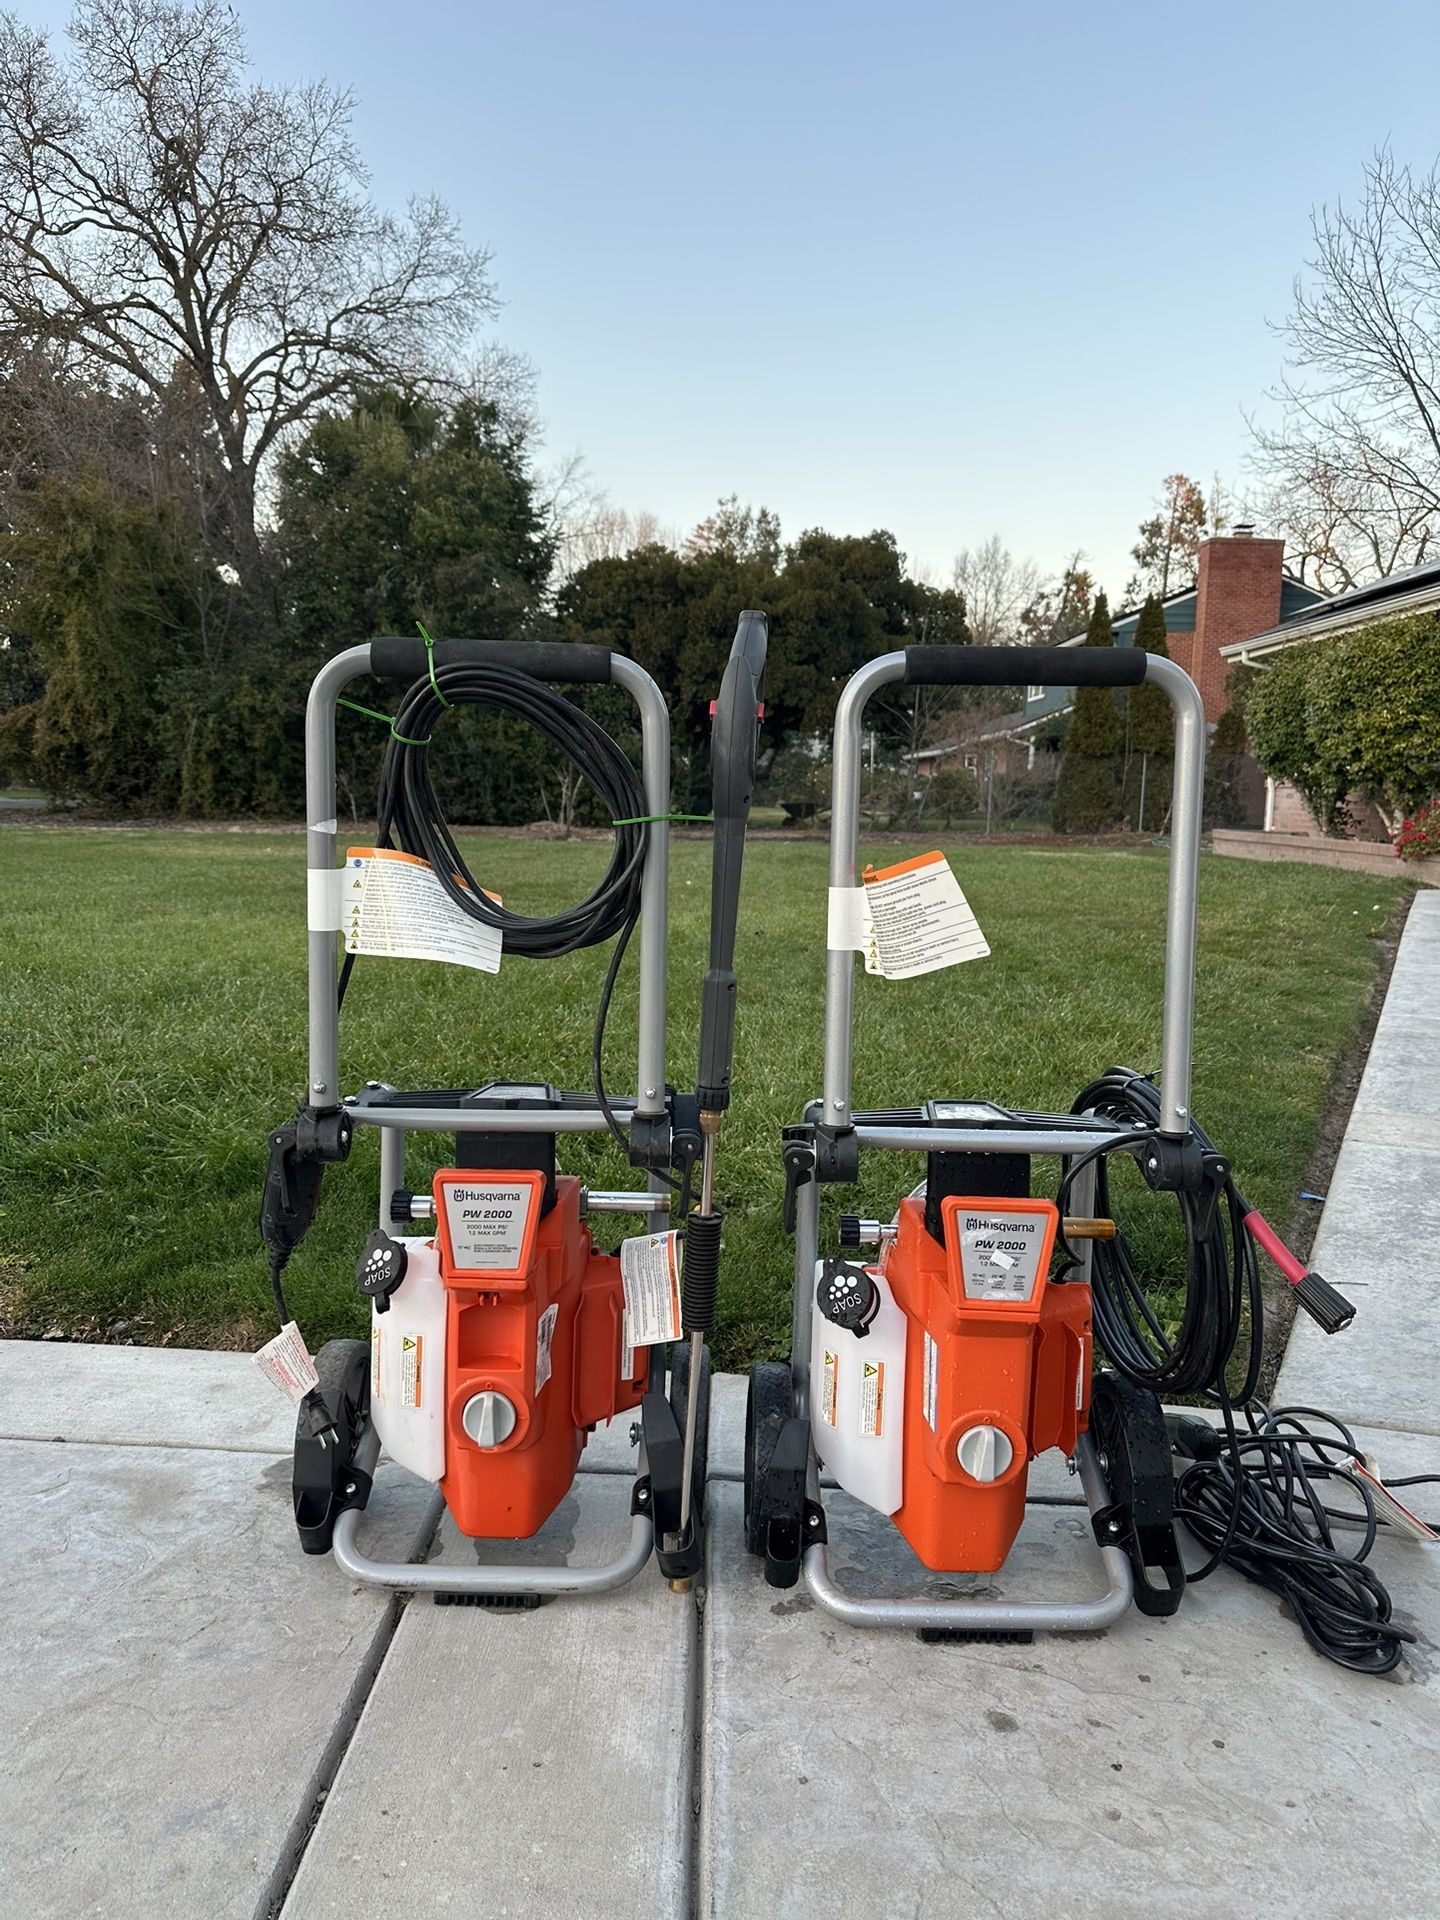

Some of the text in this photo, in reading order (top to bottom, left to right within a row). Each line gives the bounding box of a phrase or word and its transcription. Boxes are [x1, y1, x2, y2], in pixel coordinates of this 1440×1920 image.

[465, 1191, 521, 1202] Husqvarna
[462, 1210, 513, 1219] PW 2000
[978, 1220, 1035, 1233] Husqvarna
[974, 1240, 1027, 1251] PW 2000
[364, 1266, 391, 1286] SOAP
[832, 1292, 862, 1314] SOAP
